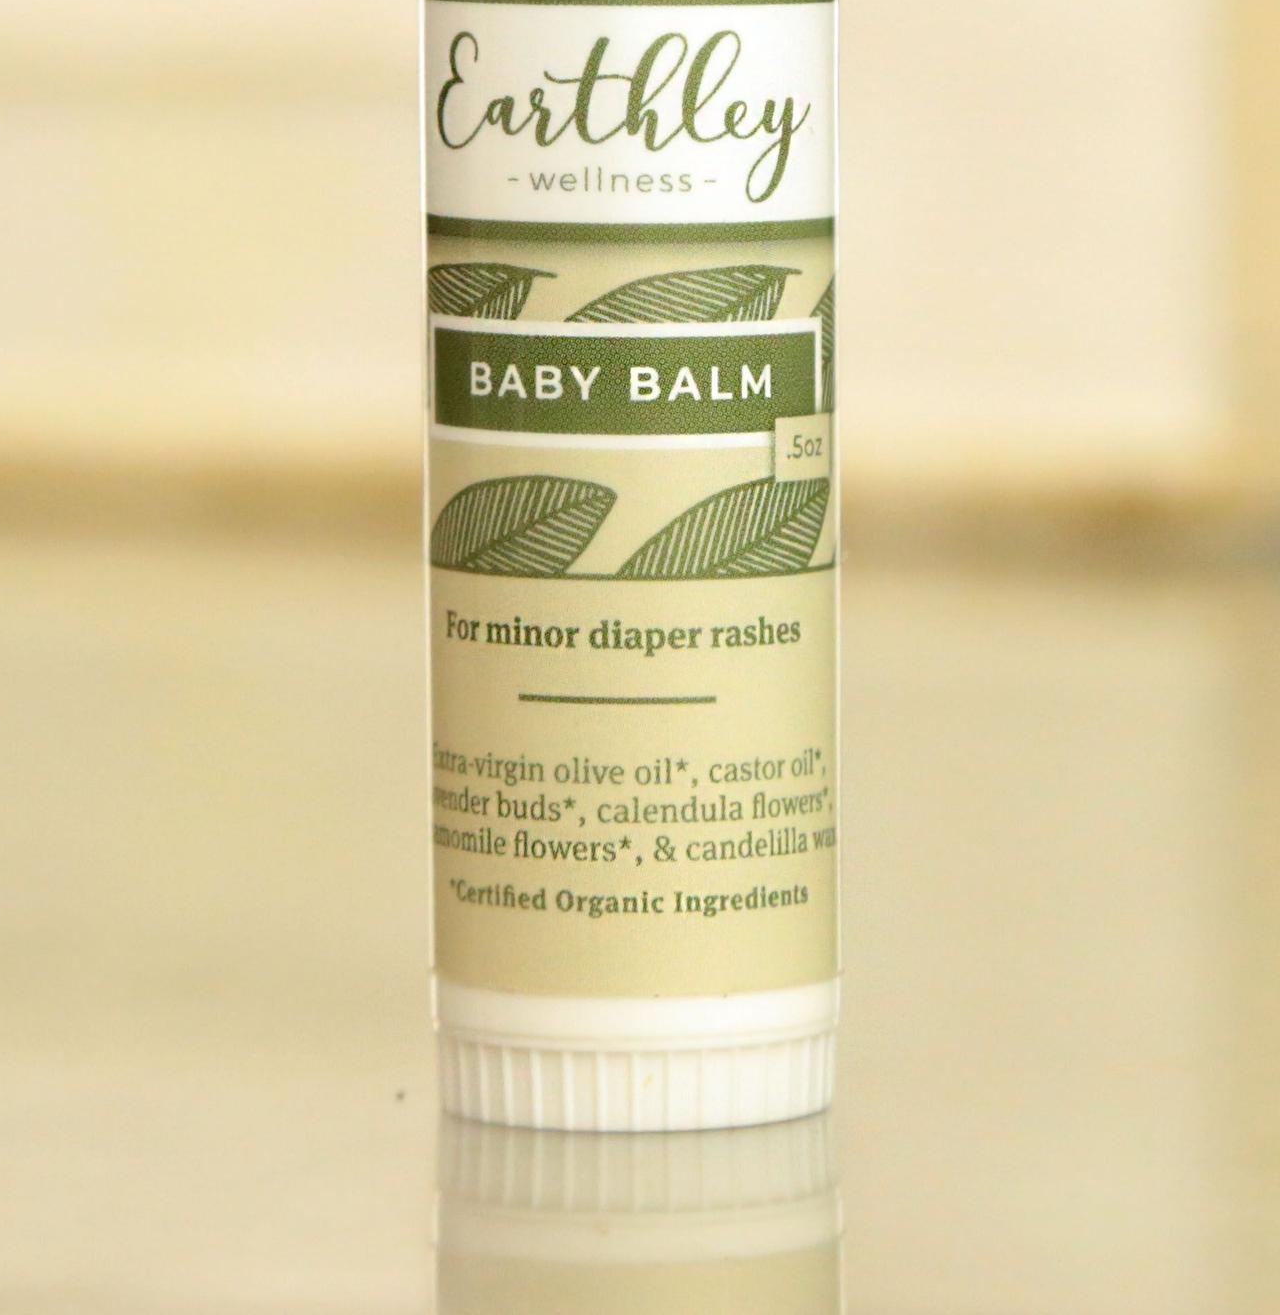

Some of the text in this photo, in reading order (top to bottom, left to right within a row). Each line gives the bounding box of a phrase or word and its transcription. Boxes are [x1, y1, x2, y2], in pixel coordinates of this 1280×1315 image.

[437, 30, 811, 203] Earthley
[469, 361, 773, 402] BABY BALM
[786, 434, 824, 460] .5oz
[446, 610, 802, 657] For minor diaper rashes
[554, 757, 625, 785] olive
[709, 757, 786, 784] castor
[597, 795, 744, 824] calendula
[653, 835, 677, 862] &
[685, 827, 808, 862] candelilla
[812, 827, 836, 850] wa
[555, 889, 665, 919] Organic
[673, 884, 810, 918] Ingredients
